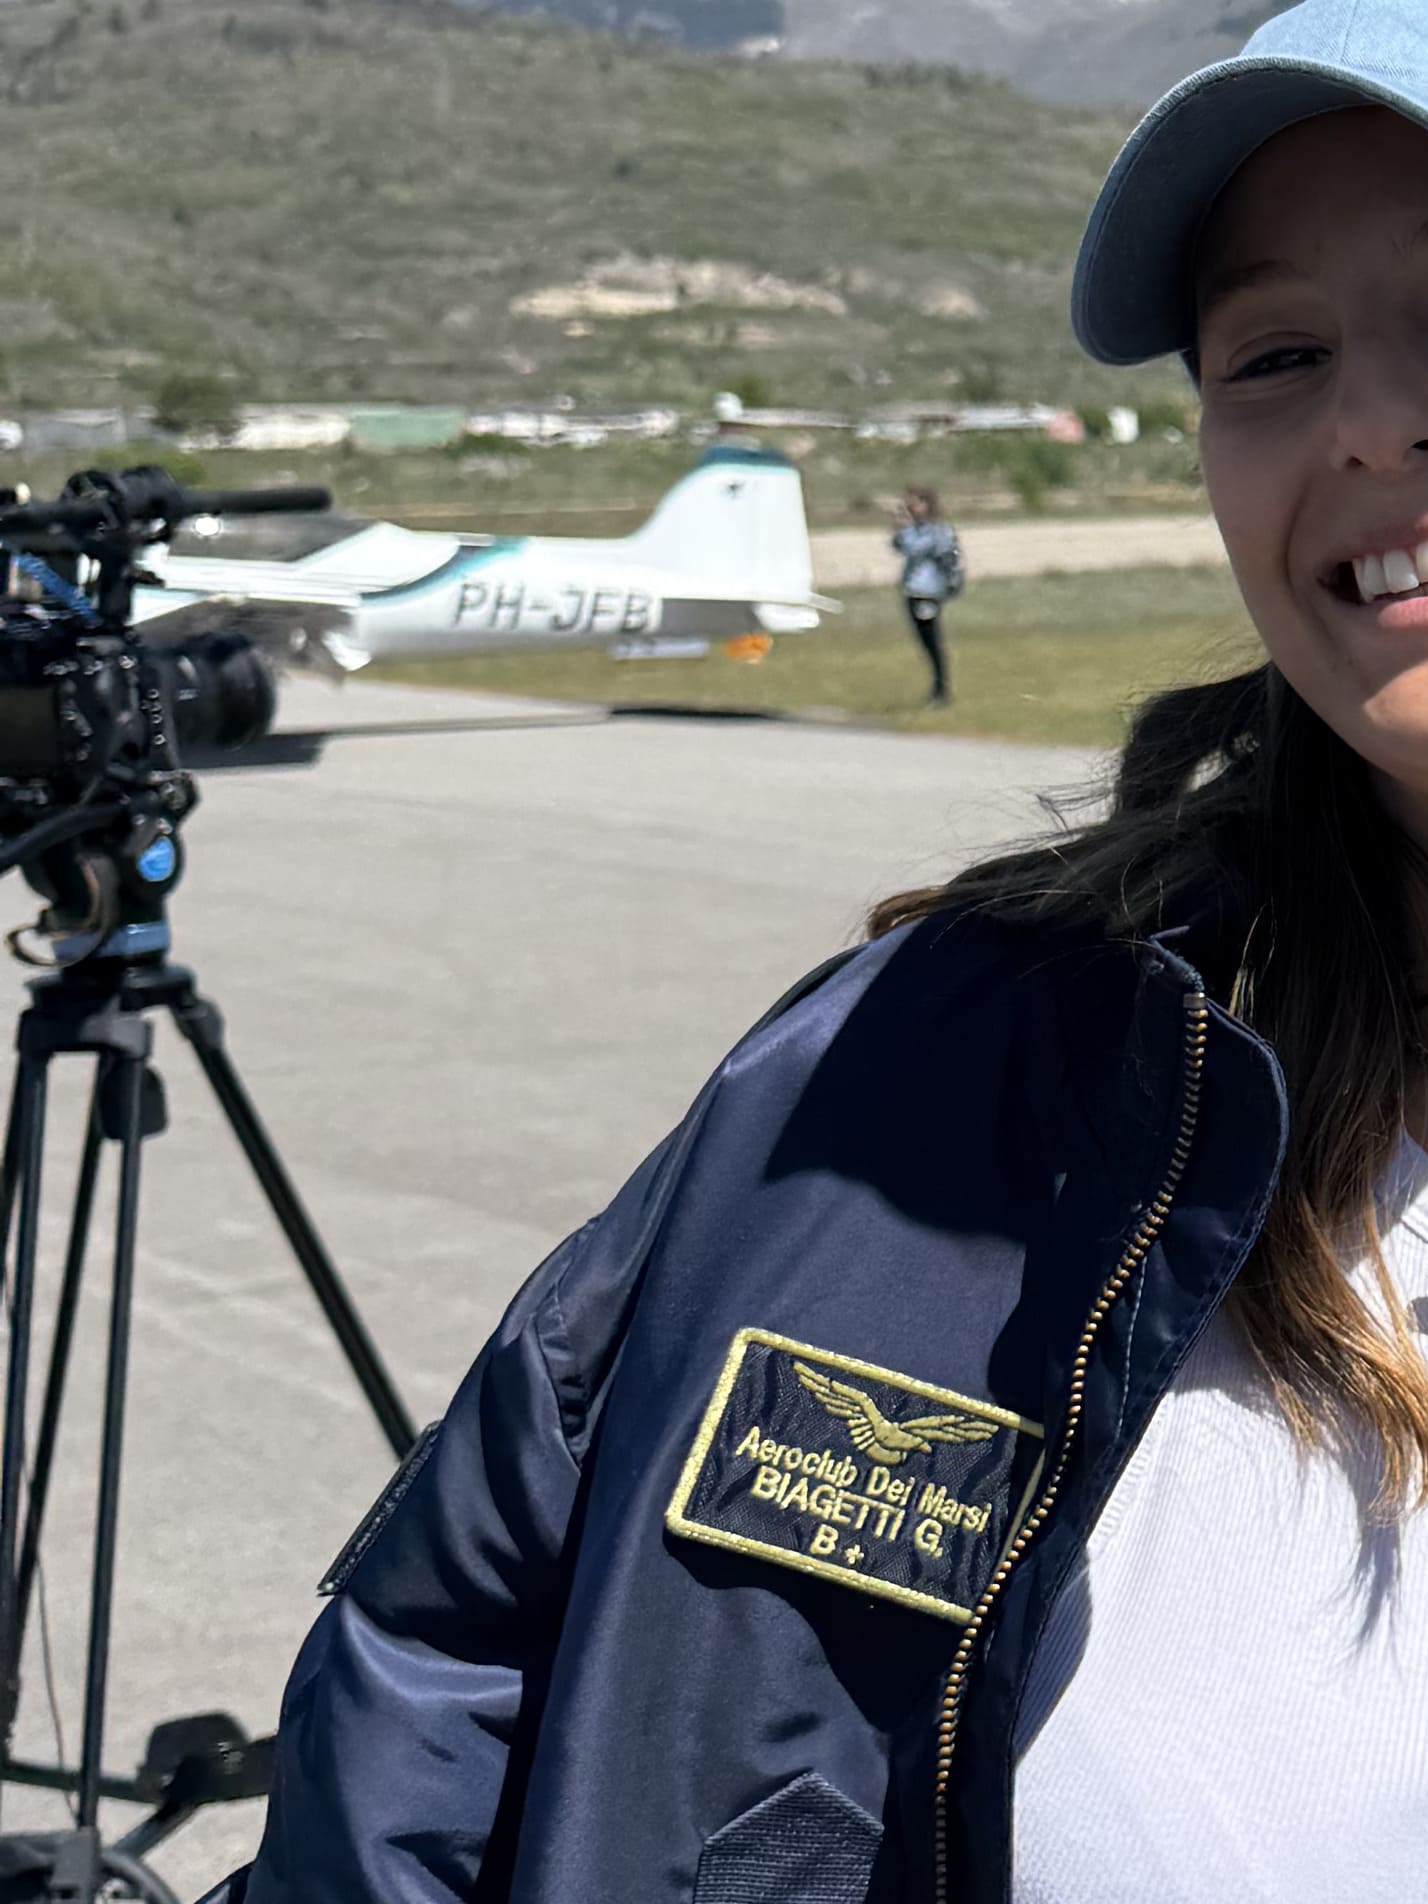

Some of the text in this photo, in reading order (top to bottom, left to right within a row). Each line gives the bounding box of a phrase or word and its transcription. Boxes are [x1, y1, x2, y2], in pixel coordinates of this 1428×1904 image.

[735, 1426, 992, 1534] Aeroclub Dei Marsi
[751, 1465, 943, 1559] BIAGETTI G.
